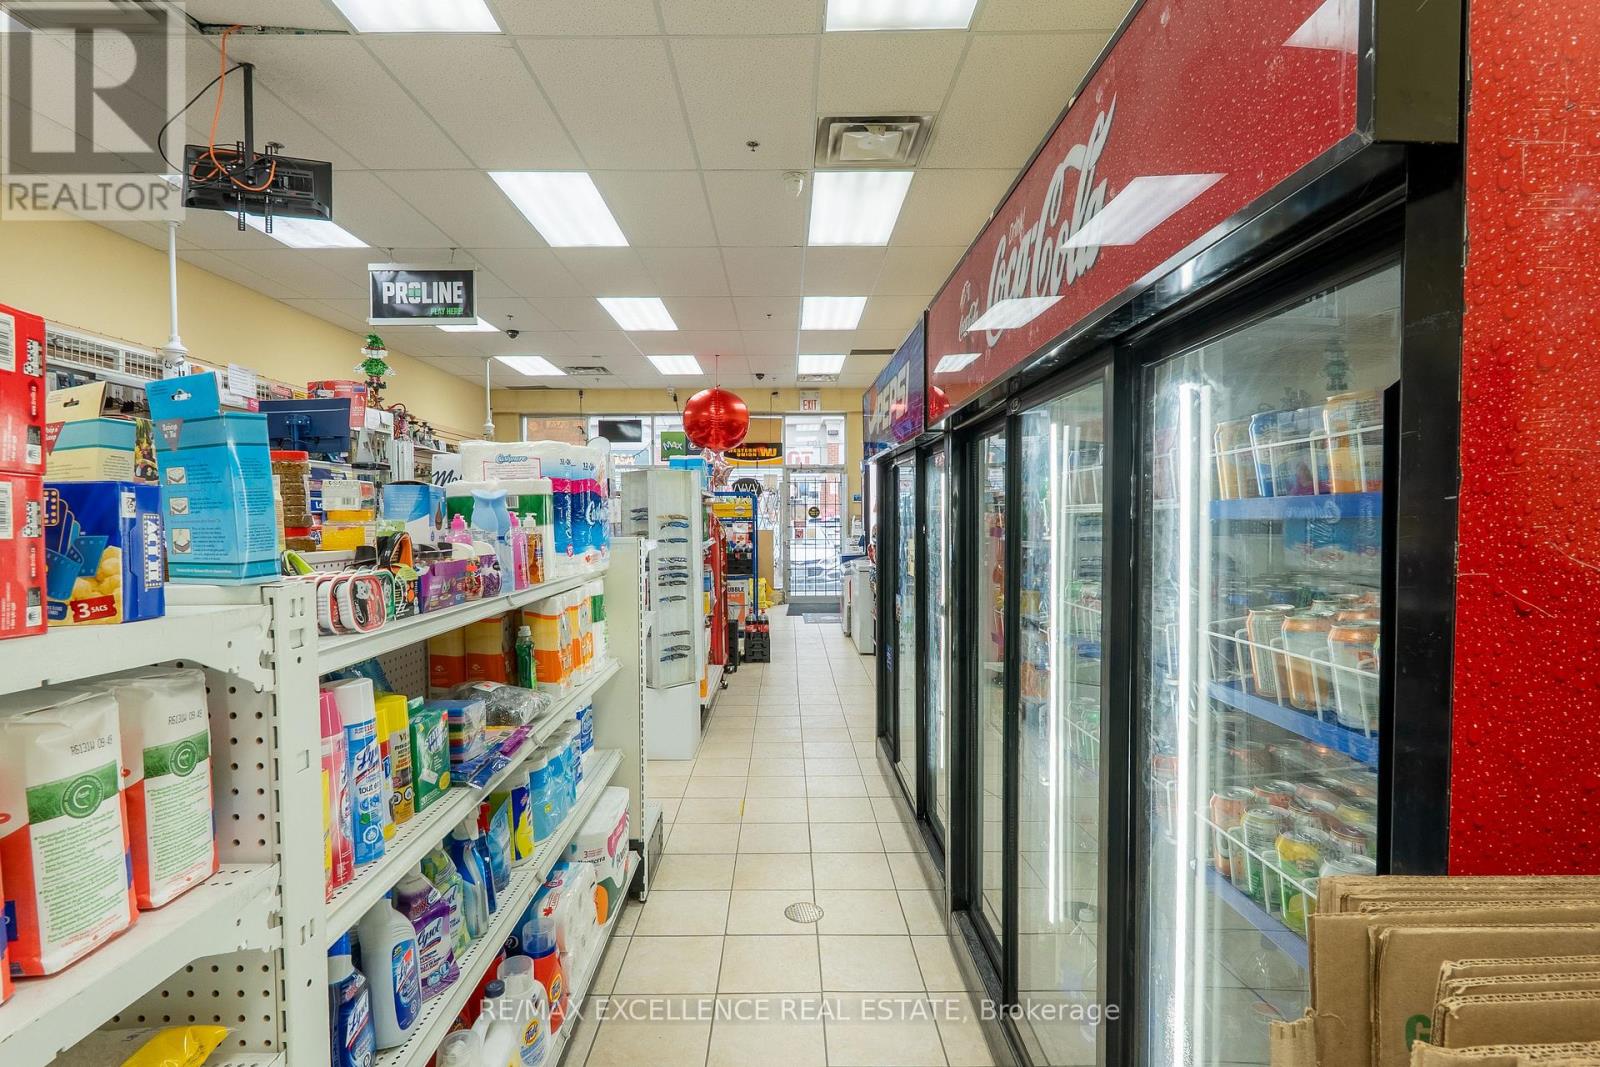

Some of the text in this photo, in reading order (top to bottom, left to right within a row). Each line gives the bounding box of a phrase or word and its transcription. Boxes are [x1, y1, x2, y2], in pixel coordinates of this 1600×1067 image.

[986, 91, 1118, 348] Coca-Cola
[382, 281, 464, 304] PROLINE
[803, 399, 817, 411] EXIT
[77, 602, 92, 618] 3
[91, 605, 108, 614] SACS
[417, 919, 443, 949] Lysol
